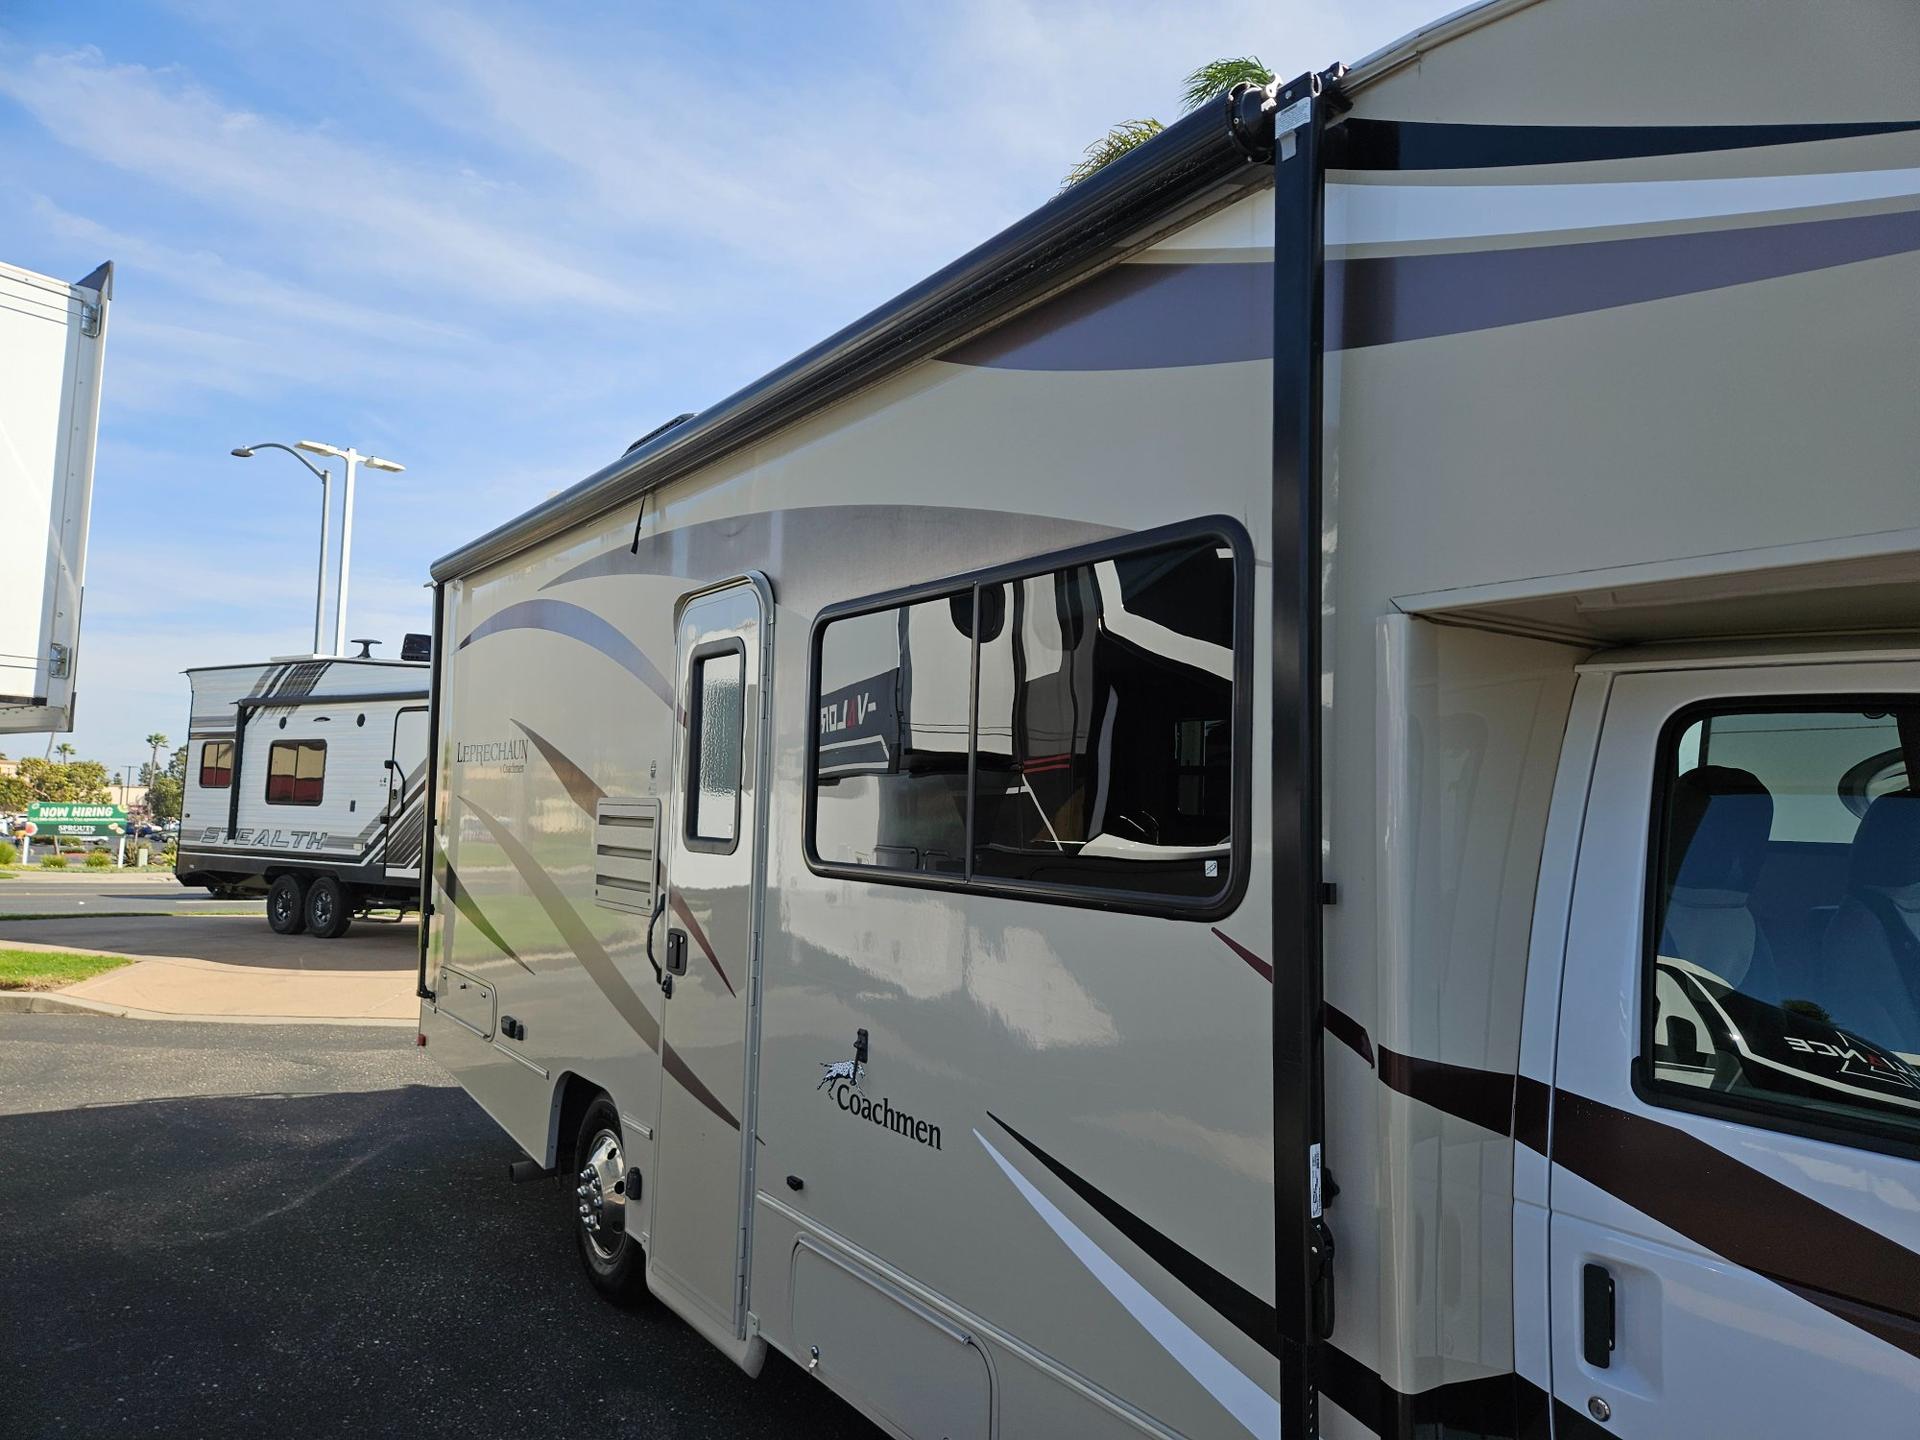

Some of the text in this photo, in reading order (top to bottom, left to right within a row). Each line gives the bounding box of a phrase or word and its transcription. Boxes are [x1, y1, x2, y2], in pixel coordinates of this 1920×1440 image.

[457, 739, 529, 767] LEPRECHAUN
[40, 806, 114, 817] NOW HIRING
[58, 824, 96, 833] SPROUTS
[836, 1083, 943, 1151] Coachmen
